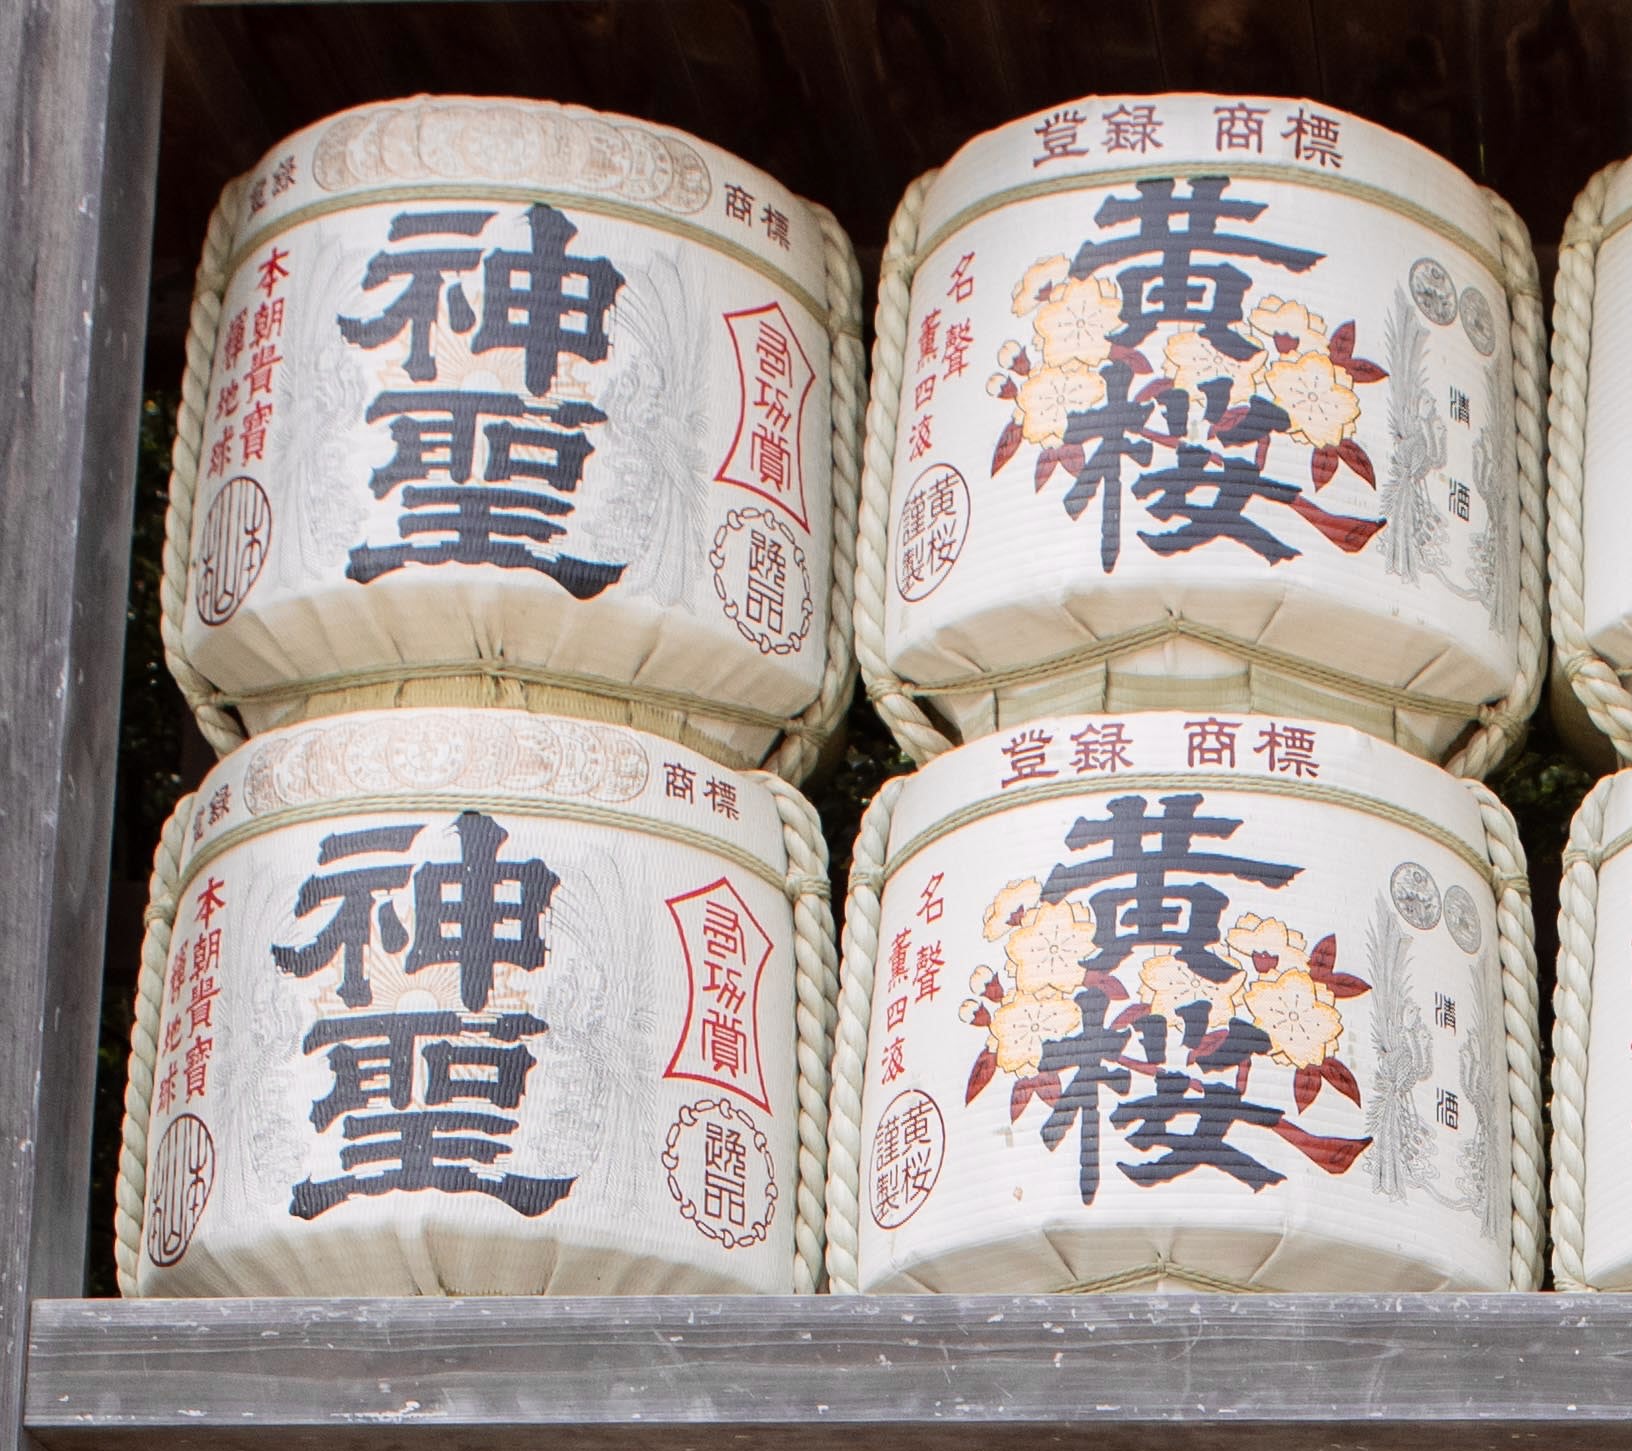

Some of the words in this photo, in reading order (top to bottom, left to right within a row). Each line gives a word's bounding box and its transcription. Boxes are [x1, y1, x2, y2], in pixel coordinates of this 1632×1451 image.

[1034, 105, 1163, 166] 登録
[1213, 104, 1343, 168] 商標
[337, 202, 632, 599] 神聖
[1001, 721, 1134, 788] 登録
[1184, 718, 1319, 780] 商標
[271, 811, 579, 1219] 神聖
